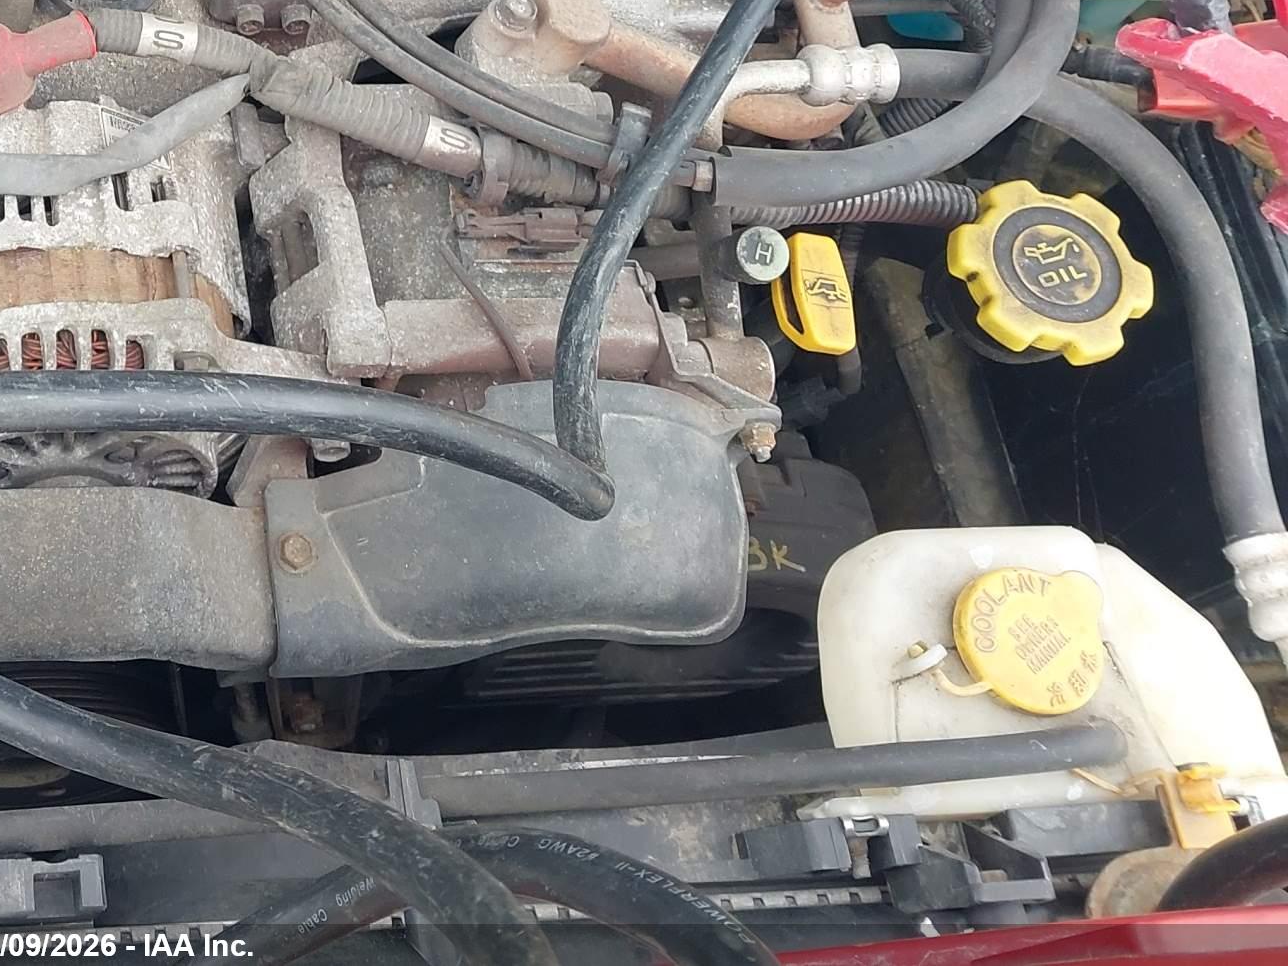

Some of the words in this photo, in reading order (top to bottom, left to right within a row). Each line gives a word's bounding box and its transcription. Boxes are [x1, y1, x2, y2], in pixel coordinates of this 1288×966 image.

[754, 241, 773, 264] H
[1038, 265, 1088, 288] OIL
[970, 572, 1053, 654] COOLANT
